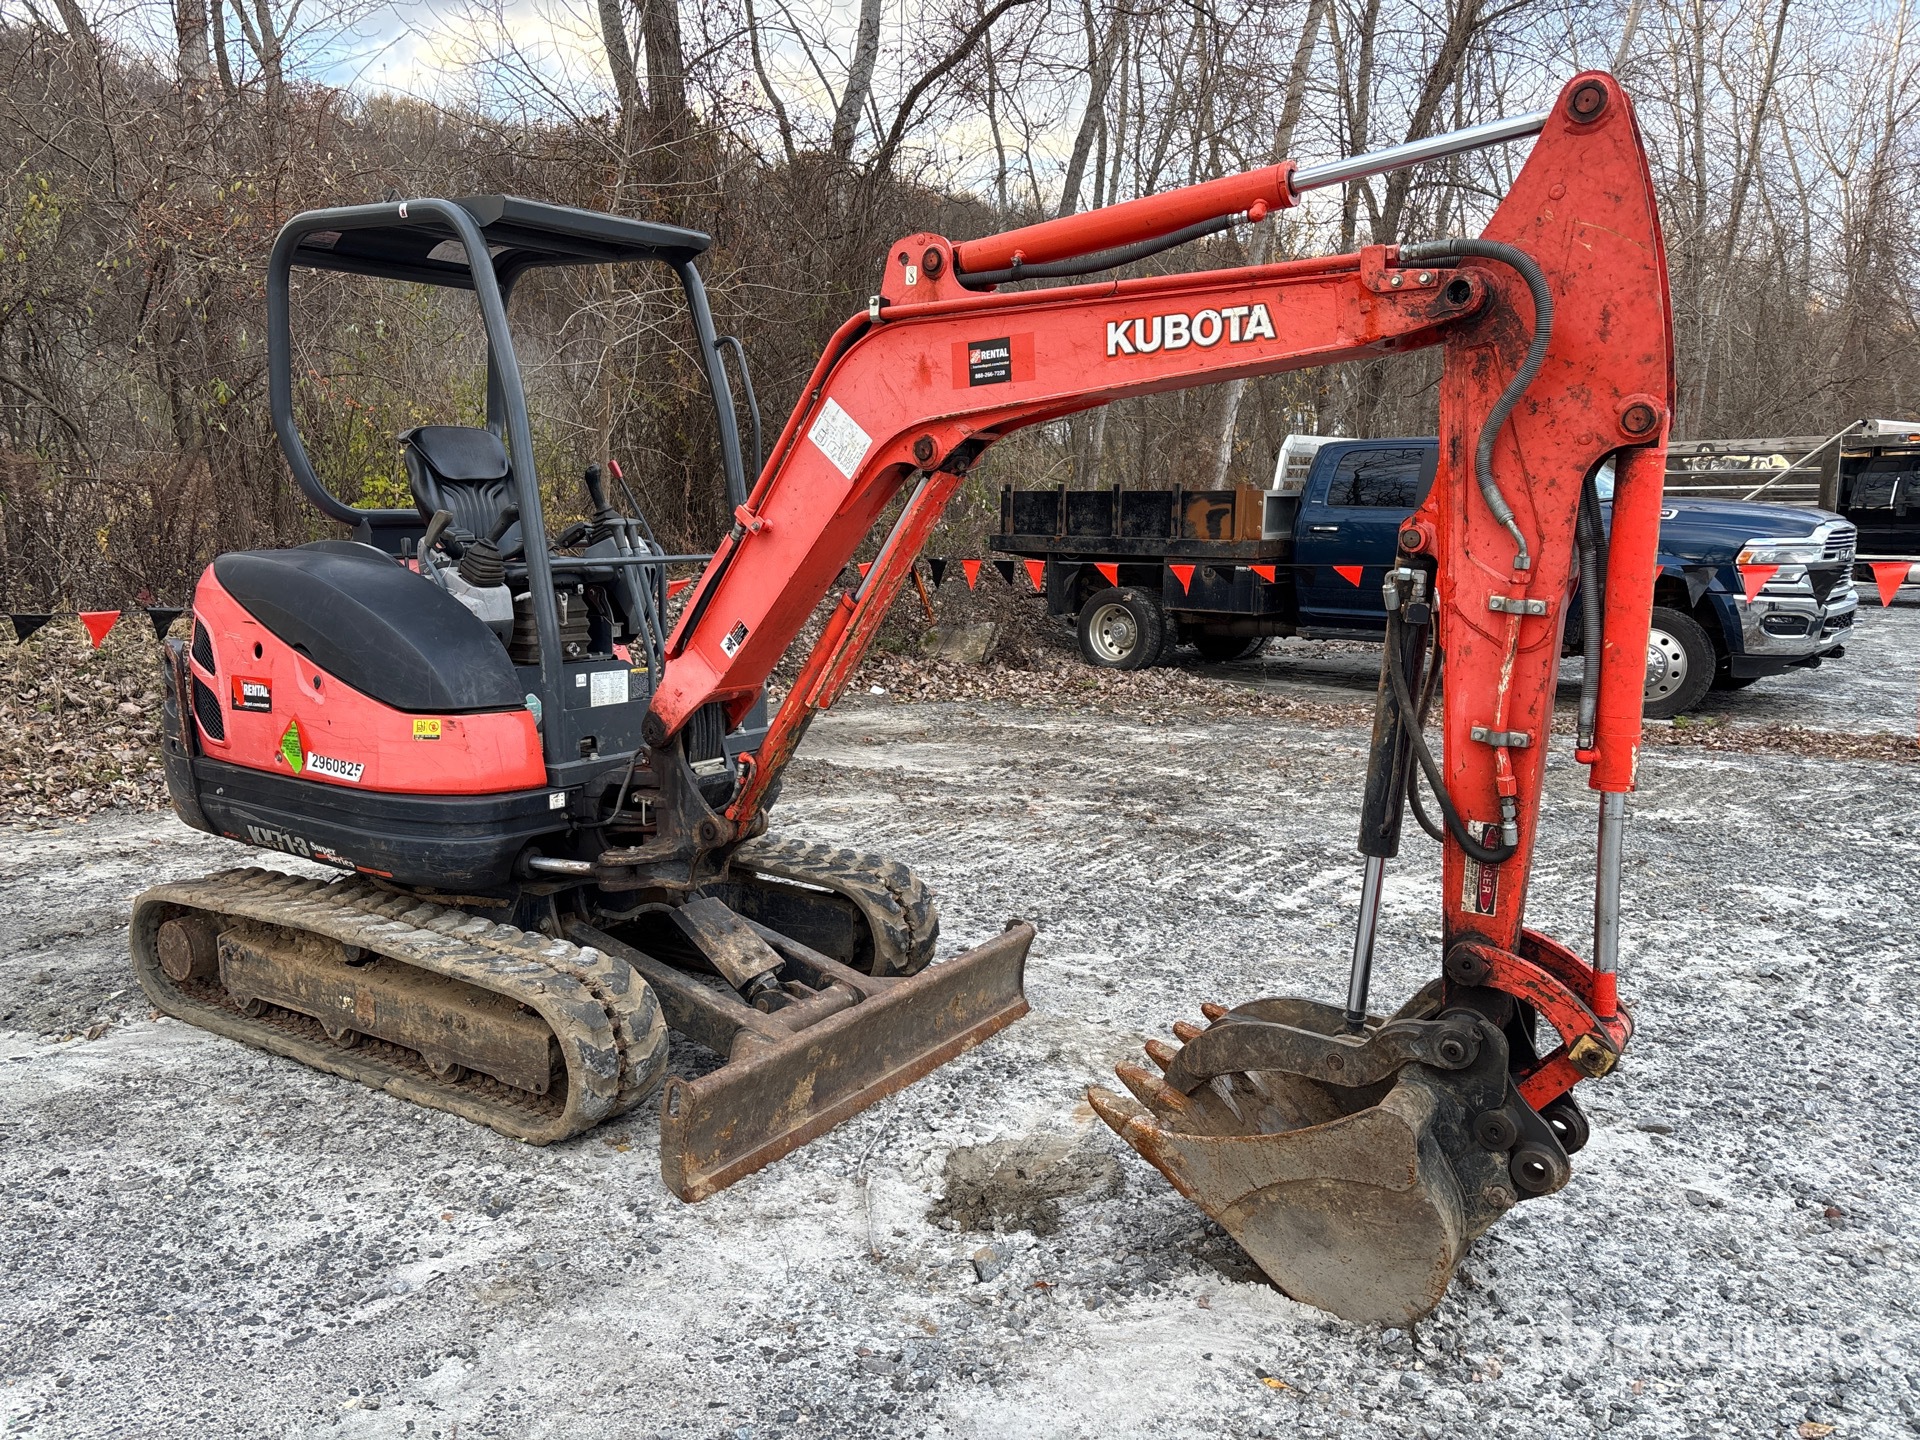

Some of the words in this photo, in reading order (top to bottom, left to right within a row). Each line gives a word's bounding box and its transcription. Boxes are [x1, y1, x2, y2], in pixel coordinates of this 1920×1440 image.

[1106, 303, 1276, 356] KUBOTA
[981, 348, 1009, 360] RENTAL
[243, 683, 270, 698] RENTAL
[311, 753, 362, 777] 2960825
[309, 841, 336, 856] Super
[326, 853, 355, 868] Series
